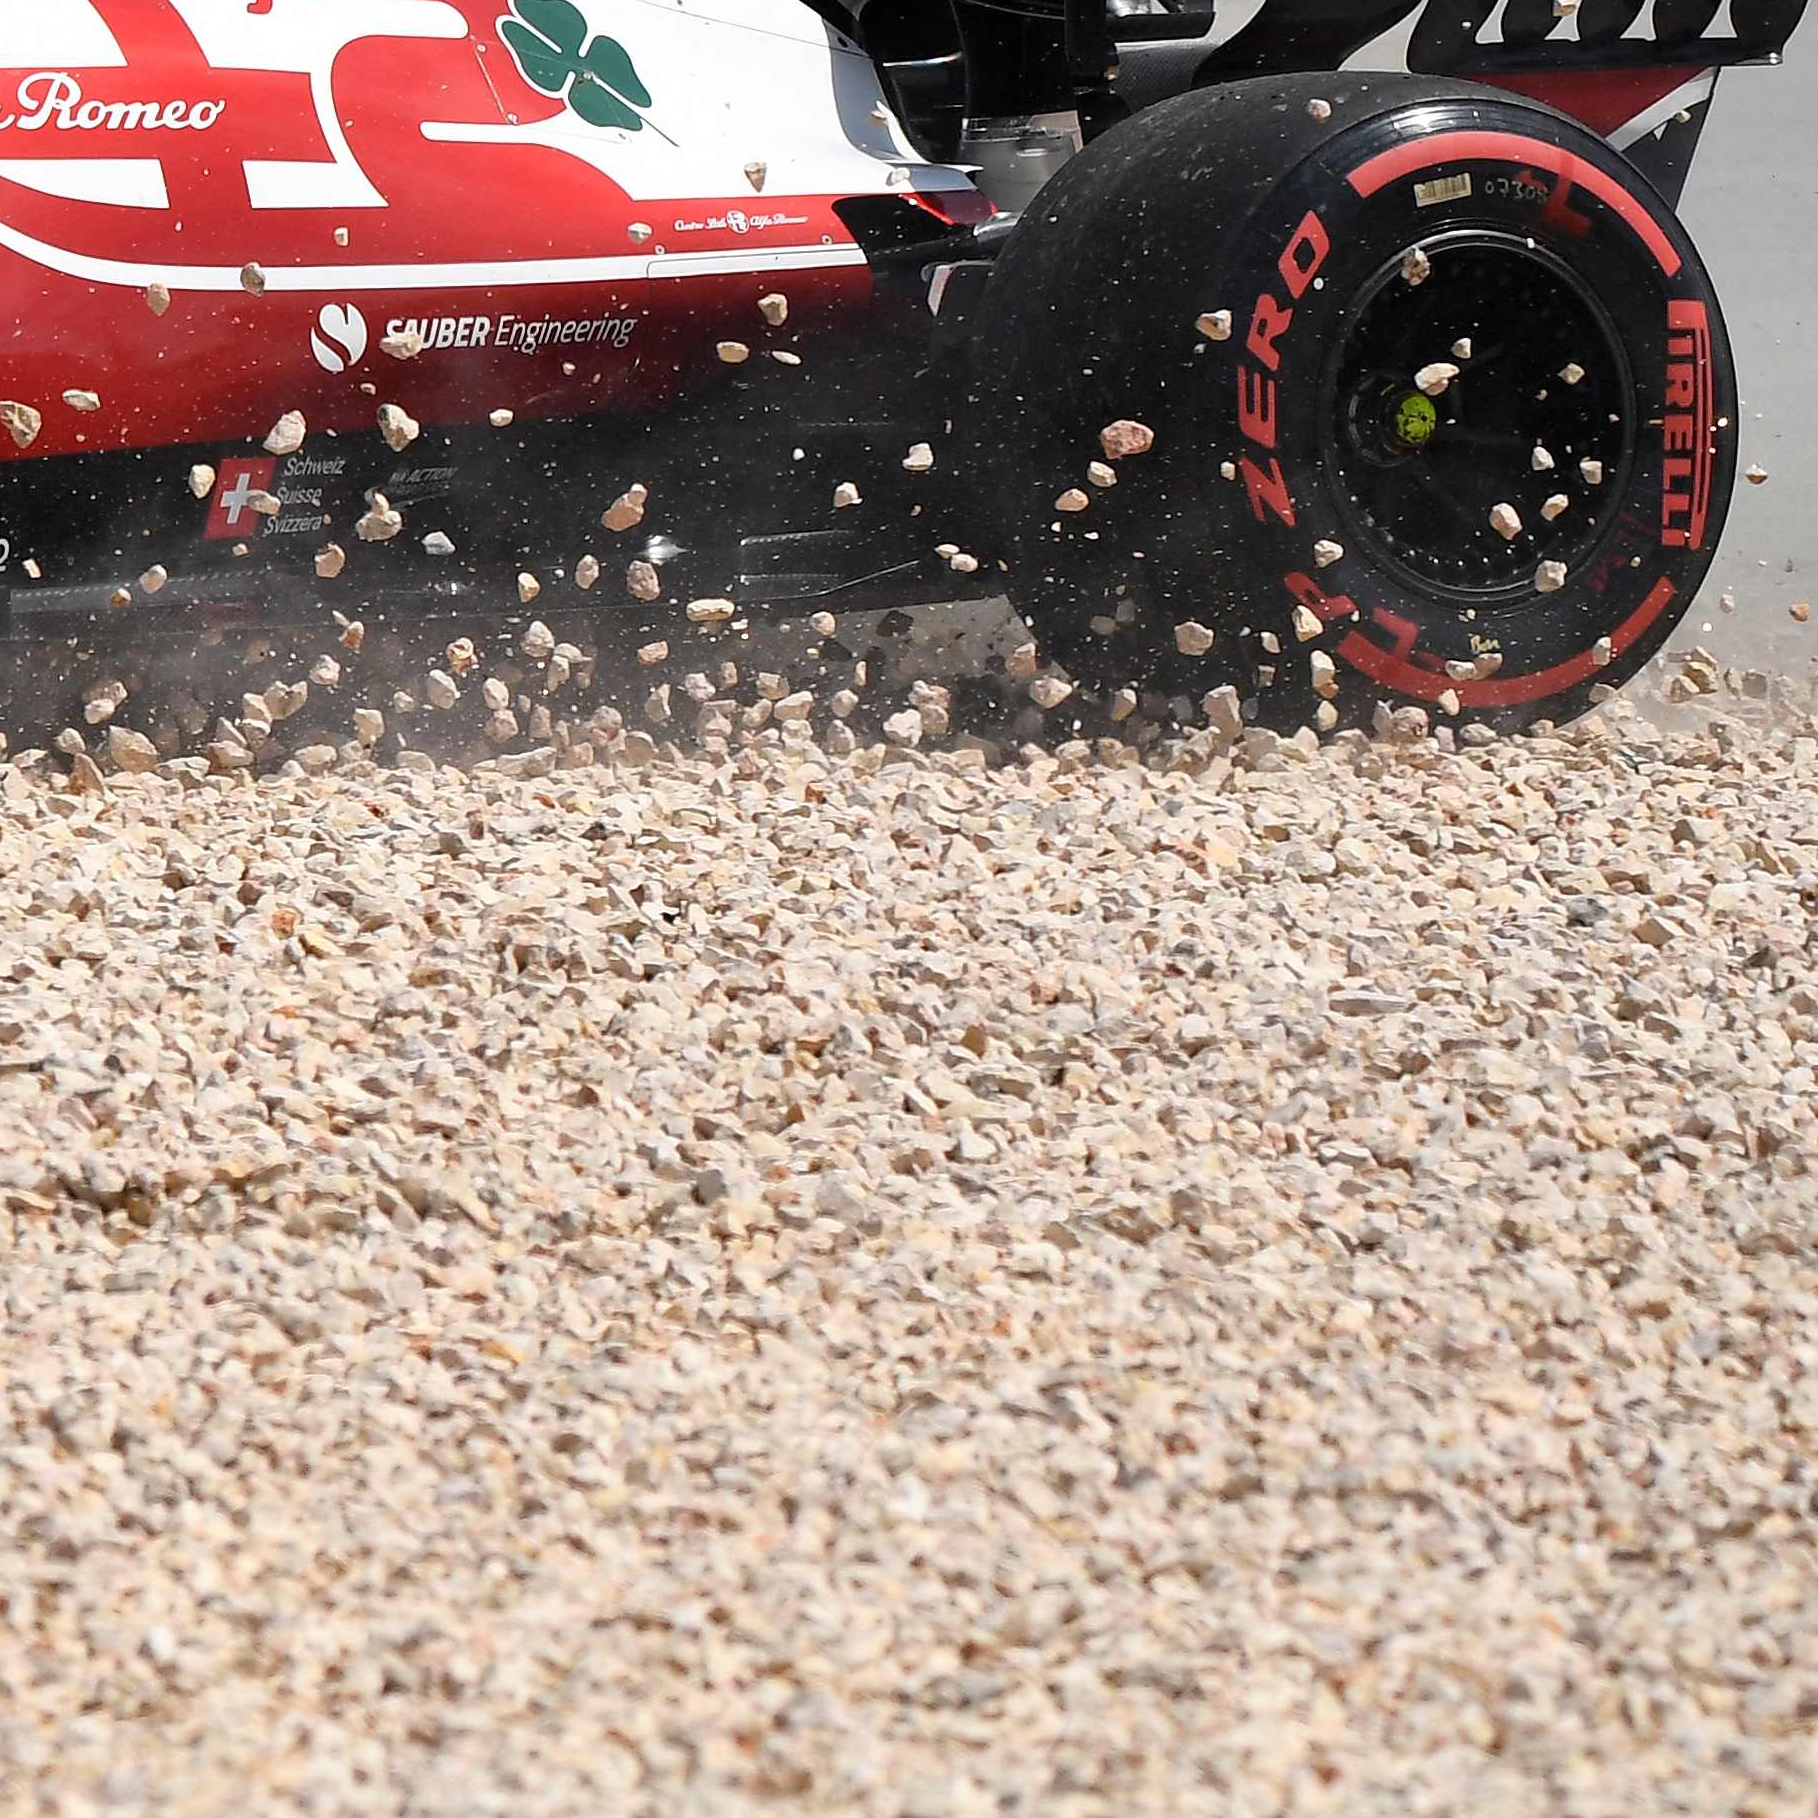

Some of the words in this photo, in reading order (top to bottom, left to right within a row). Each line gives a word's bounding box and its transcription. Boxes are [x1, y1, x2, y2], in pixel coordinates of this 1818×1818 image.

[15, 70, 227, 132] Romeo
[385, 316, 490, 351] SAUBER
[493, 313, 639, 350] Engineering
[1236, 208, 1331, 528] ZERO
[1659, 298, 1712, 549] PIRELLI
[283, 455, 347, 477] Schweiz
[276, 485, 322, 505] Suisse
[263, 513, 324, 535] Svizzera
